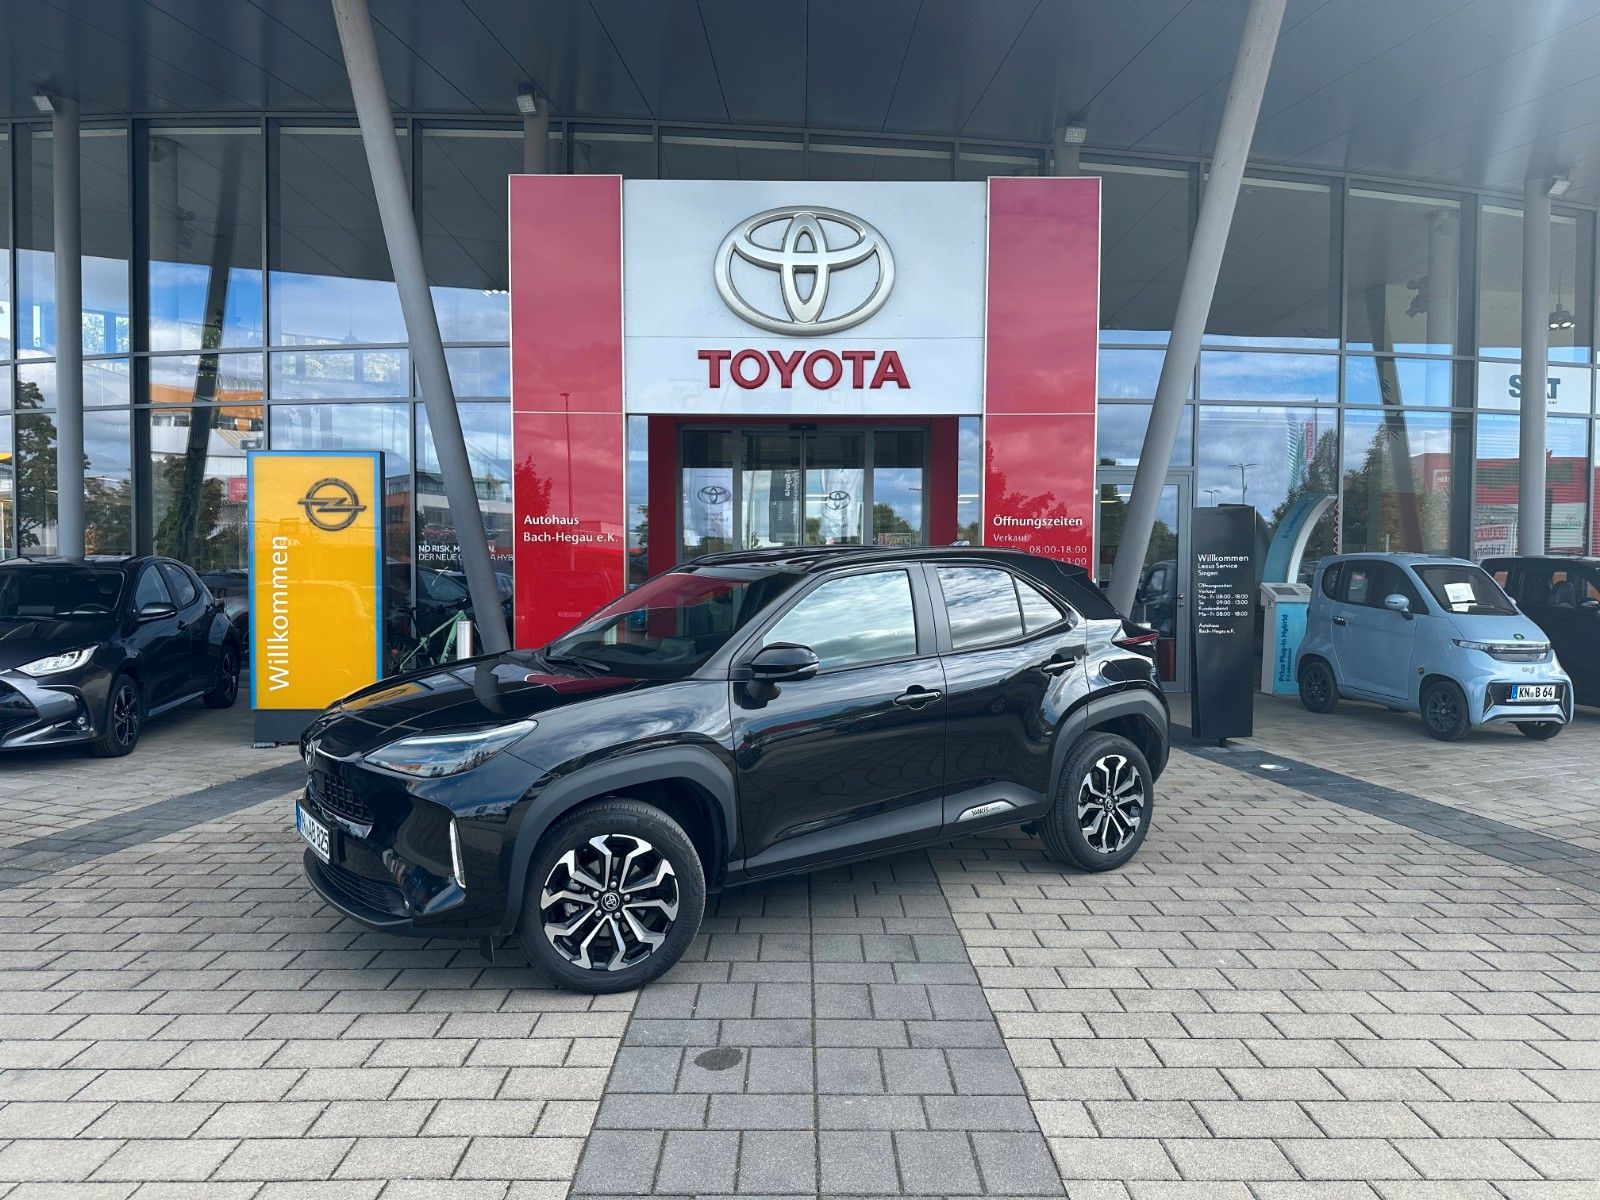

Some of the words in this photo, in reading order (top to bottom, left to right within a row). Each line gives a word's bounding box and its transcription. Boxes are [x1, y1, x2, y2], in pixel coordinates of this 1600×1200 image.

[698, 348, 911, 390] TOYOTA
[1508, 374, 1561, 400] ST
[524, 515, 579, 525] Autohaus
[993, 514, 1083, 529] Öffnungszeiten
[523, 532, 593, 544] Bach-Hegau
[993, 533, 1028, 542] Verkauf
[1029, 545, 1088, 554] 08:00-18:00
[418, 553, 434, 561] DER
[435, 553, 457, 561] NEUE
[1198, 554, 1249, 562] Willkommen
[266, 536, 290, 692] Willkommen
[1281, 614, 1289, 638] Hybrid
[1278, 664, 1286, 682] Prius
[1519, 687, 1530, 698] KN
[1535, 687, 1541, 698] B
[1543, 687, 1553, 698] 64
